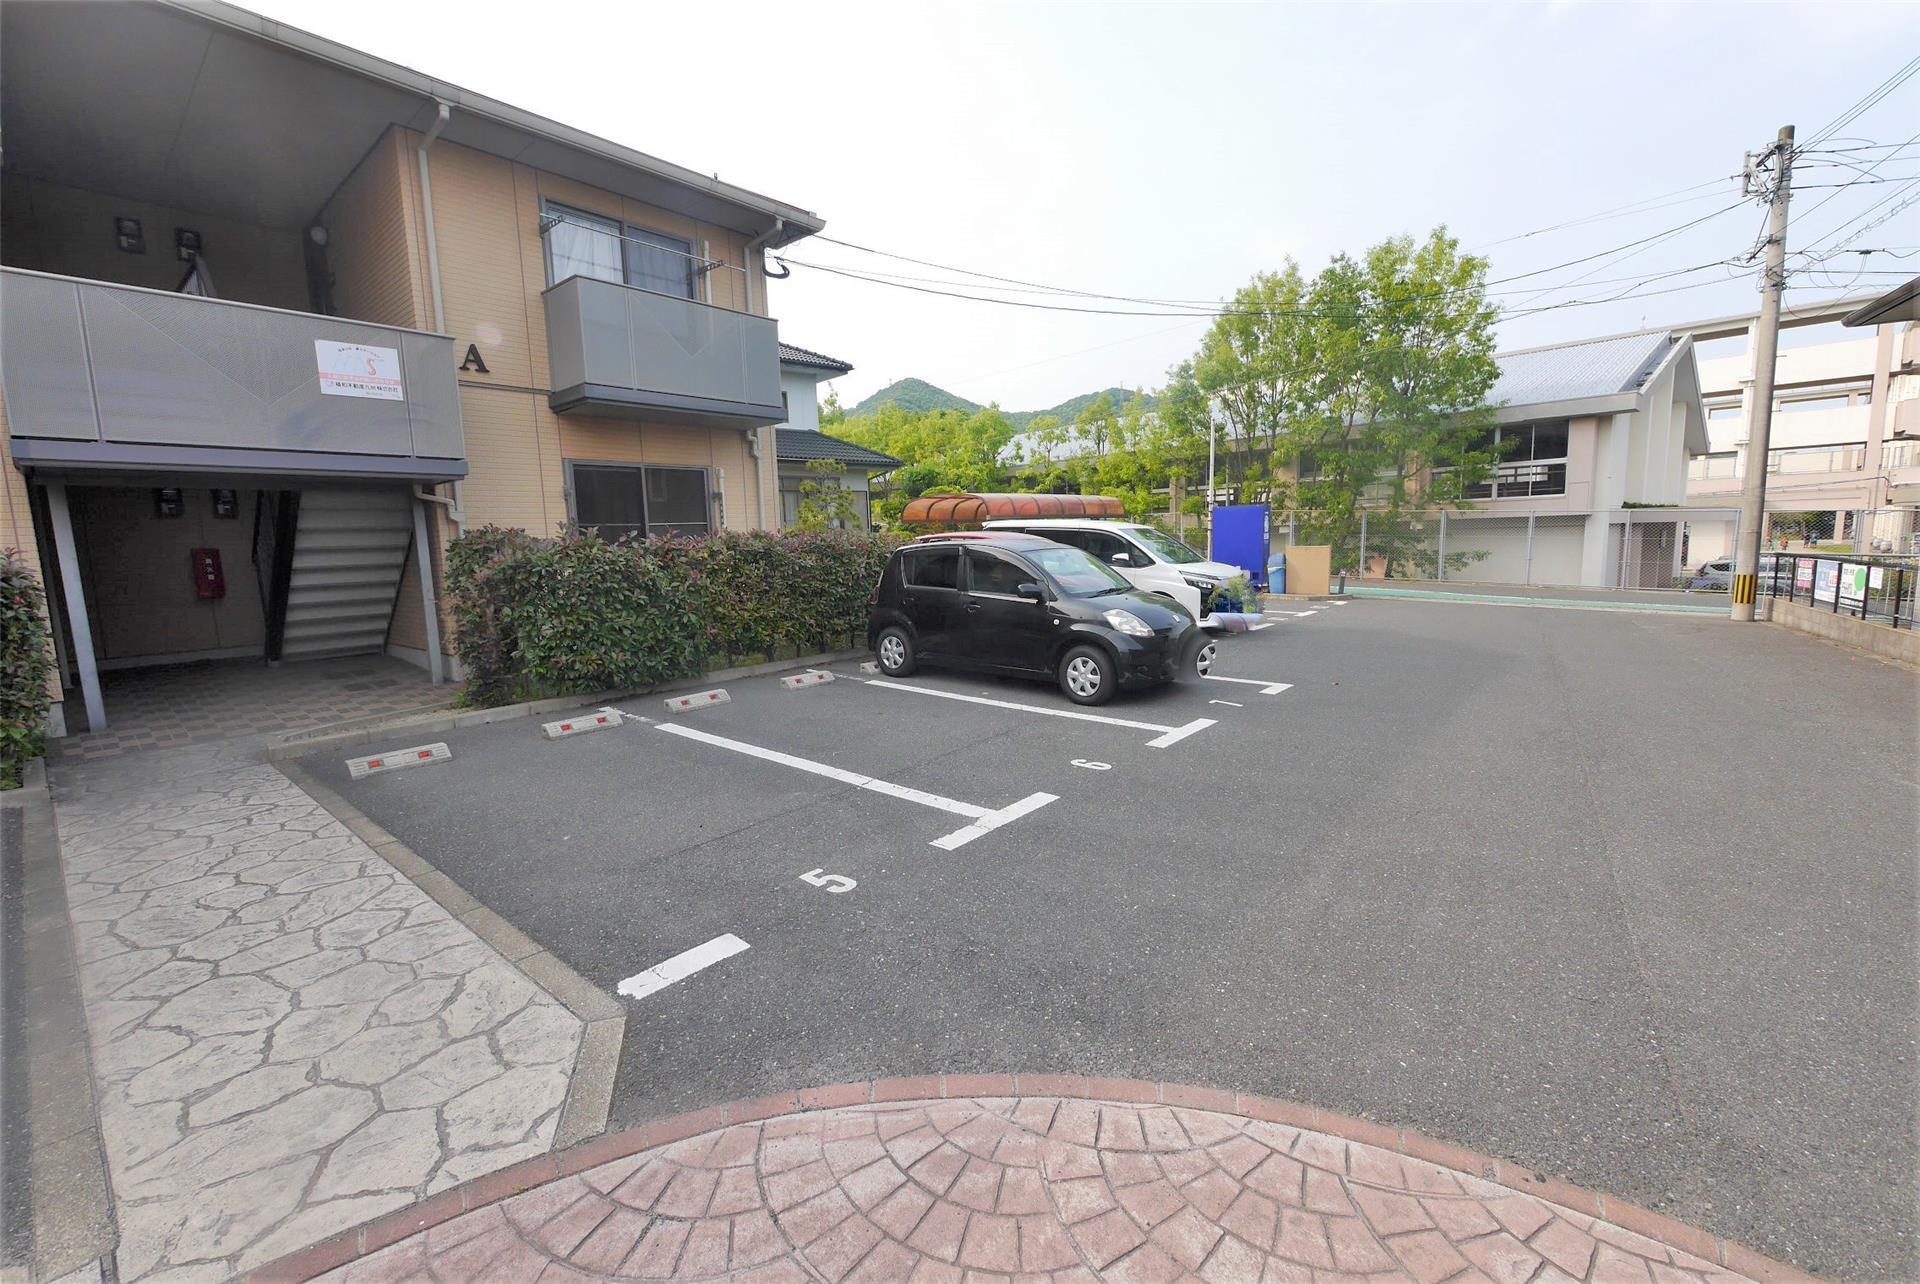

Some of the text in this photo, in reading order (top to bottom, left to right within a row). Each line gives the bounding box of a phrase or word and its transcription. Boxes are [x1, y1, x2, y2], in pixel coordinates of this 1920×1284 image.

[459, 344, 490, 373] A
[1070, 758, 1112, 770] 6
[798, 868, 857, 893] 5
